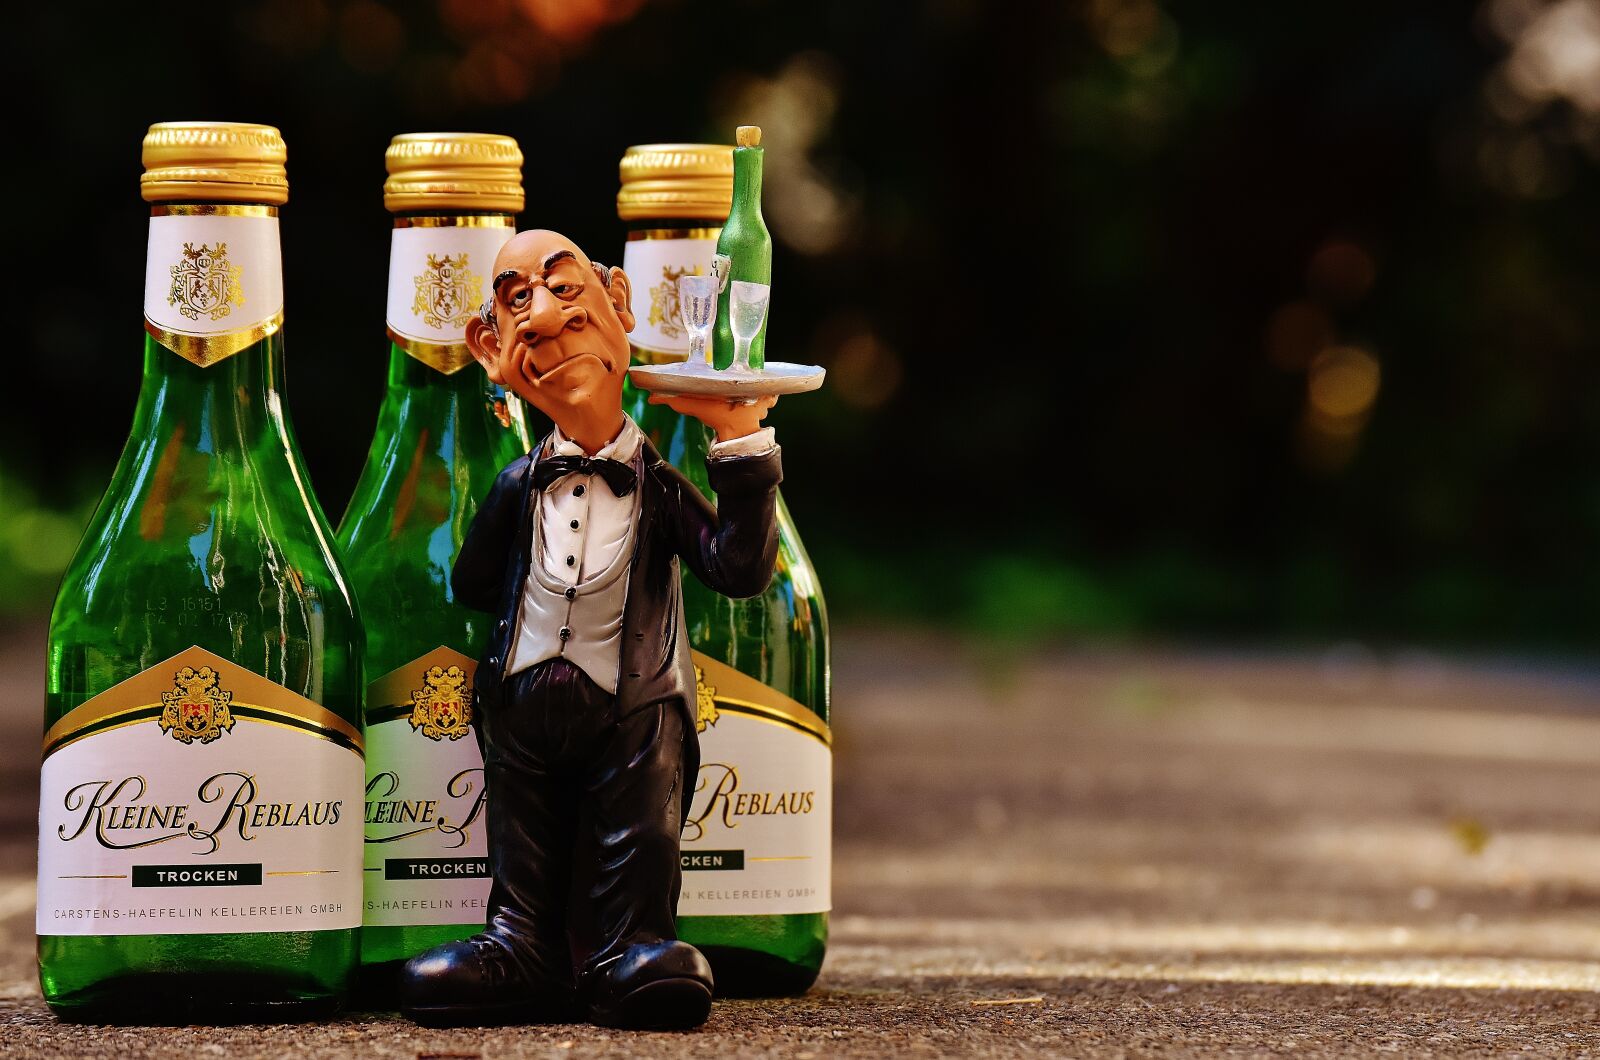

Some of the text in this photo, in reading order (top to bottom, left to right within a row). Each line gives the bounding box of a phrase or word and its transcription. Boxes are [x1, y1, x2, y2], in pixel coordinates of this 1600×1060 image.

[681, 763, 816, 841] REBLAUS
[58, 770, 343, 855] KLEINE REBLAUS
[680, 856, 723, 867] CKEN
[409, 863, 486, 875] TROCKEN
[157, 870, 238, 882] TROCKEN
[697, 890, 782, 900] KELLEREIEN
[788, 888, 816, 898] GMBH
[54, 903, 343, 919] CARSTENS-HAEFELIN KELLEREIEN GMBH
[363, 900, 453, 910] S-HAEFELIN
